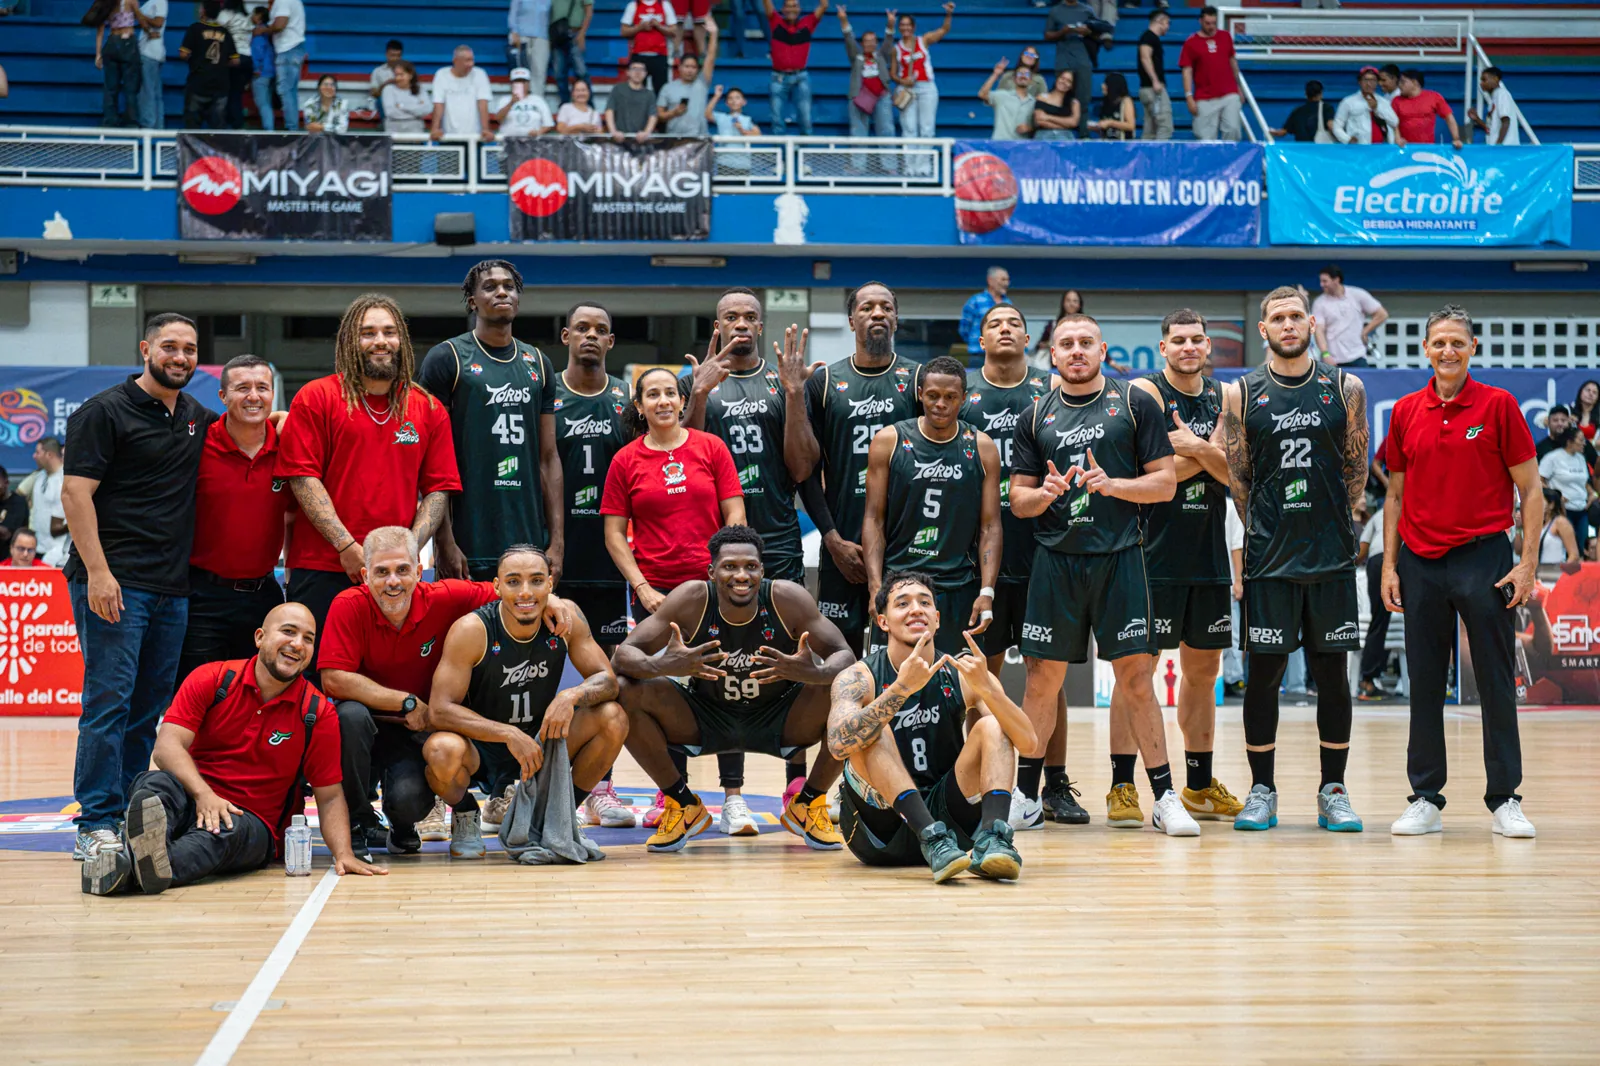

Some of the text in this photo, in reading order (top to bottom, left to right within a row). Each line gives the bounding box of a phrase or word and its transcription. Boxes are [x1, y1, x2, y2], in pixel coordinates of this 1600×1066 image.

[242, 170, 388, 197] MIYAGI
[568, 171, 710, 198] MIYAGI
[1020, 177, 1261, 206] WWW.MOLTEN.COM.CO
[267, 200, 363, 213] MASTER THE GAME
[592, 202, 687, 213] MASTER THE GAME
[1333, 182, 1503, 214] Electrolife
[1362, 219, 1477, 230] BEBIDA HIDRATANTE
[491, 413, 525, 445] 45
[729, 424, 763, 454] 33
[583, 445, 594, 474] 1
[1280, 437, 1311, 469] 22
[1069, 453, 1086, 484] 7
[922, 488, 942, 519] 5
[1283, 502, 1312, 510] EMCALI
[908, 547, 939, 556] EMCALI
[23, 620, 78, 640] paraís
[23, 637, 82, 653] de tod
[27, 688, 52, 705] del
[724, 675, 760, 701] 59
[508, 691, 533, 724] 11
[911, 737, 928, 772] 8
